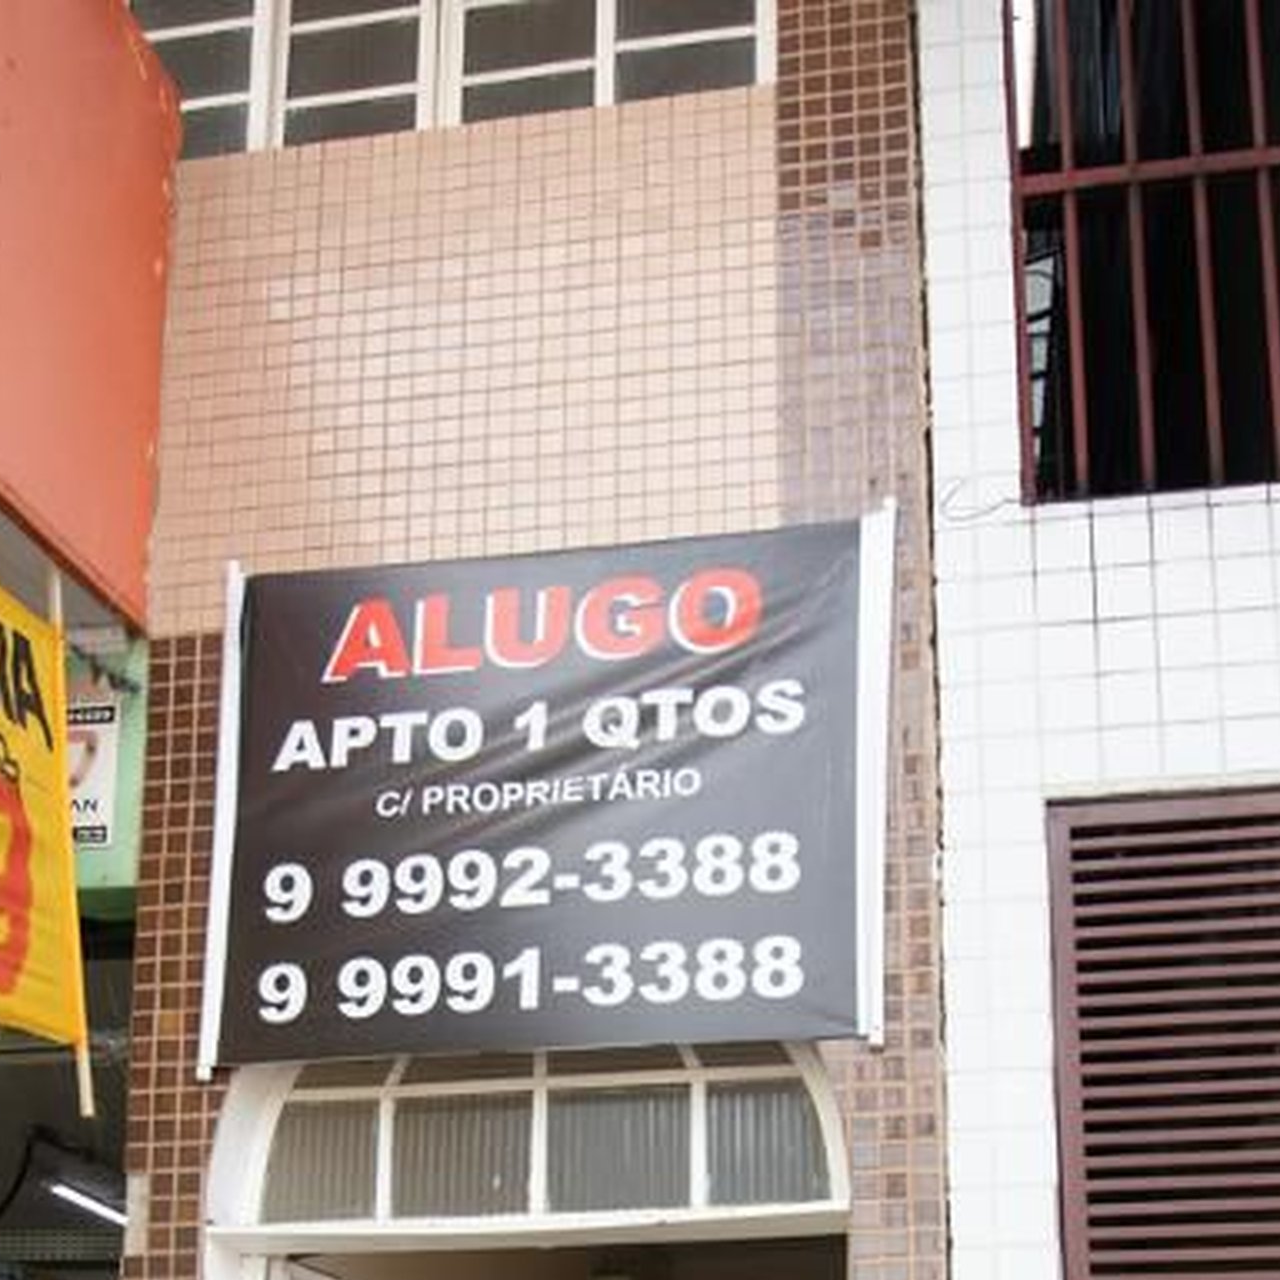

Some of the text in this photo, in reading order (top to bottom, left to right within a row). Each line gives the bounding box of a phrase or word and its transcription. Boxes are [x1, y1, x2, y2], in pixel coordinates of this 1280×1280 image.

[322, 566, 763, 684] ALUGO
[272, 679, 806, 772] APTO 1 QTOS
[376, 762, 702, 818] C/ PROPRIETÁRIO
[263, 831, 801, 922] 9 9992-3388
[258, 935, 805, 1023] 9 9991-3388
